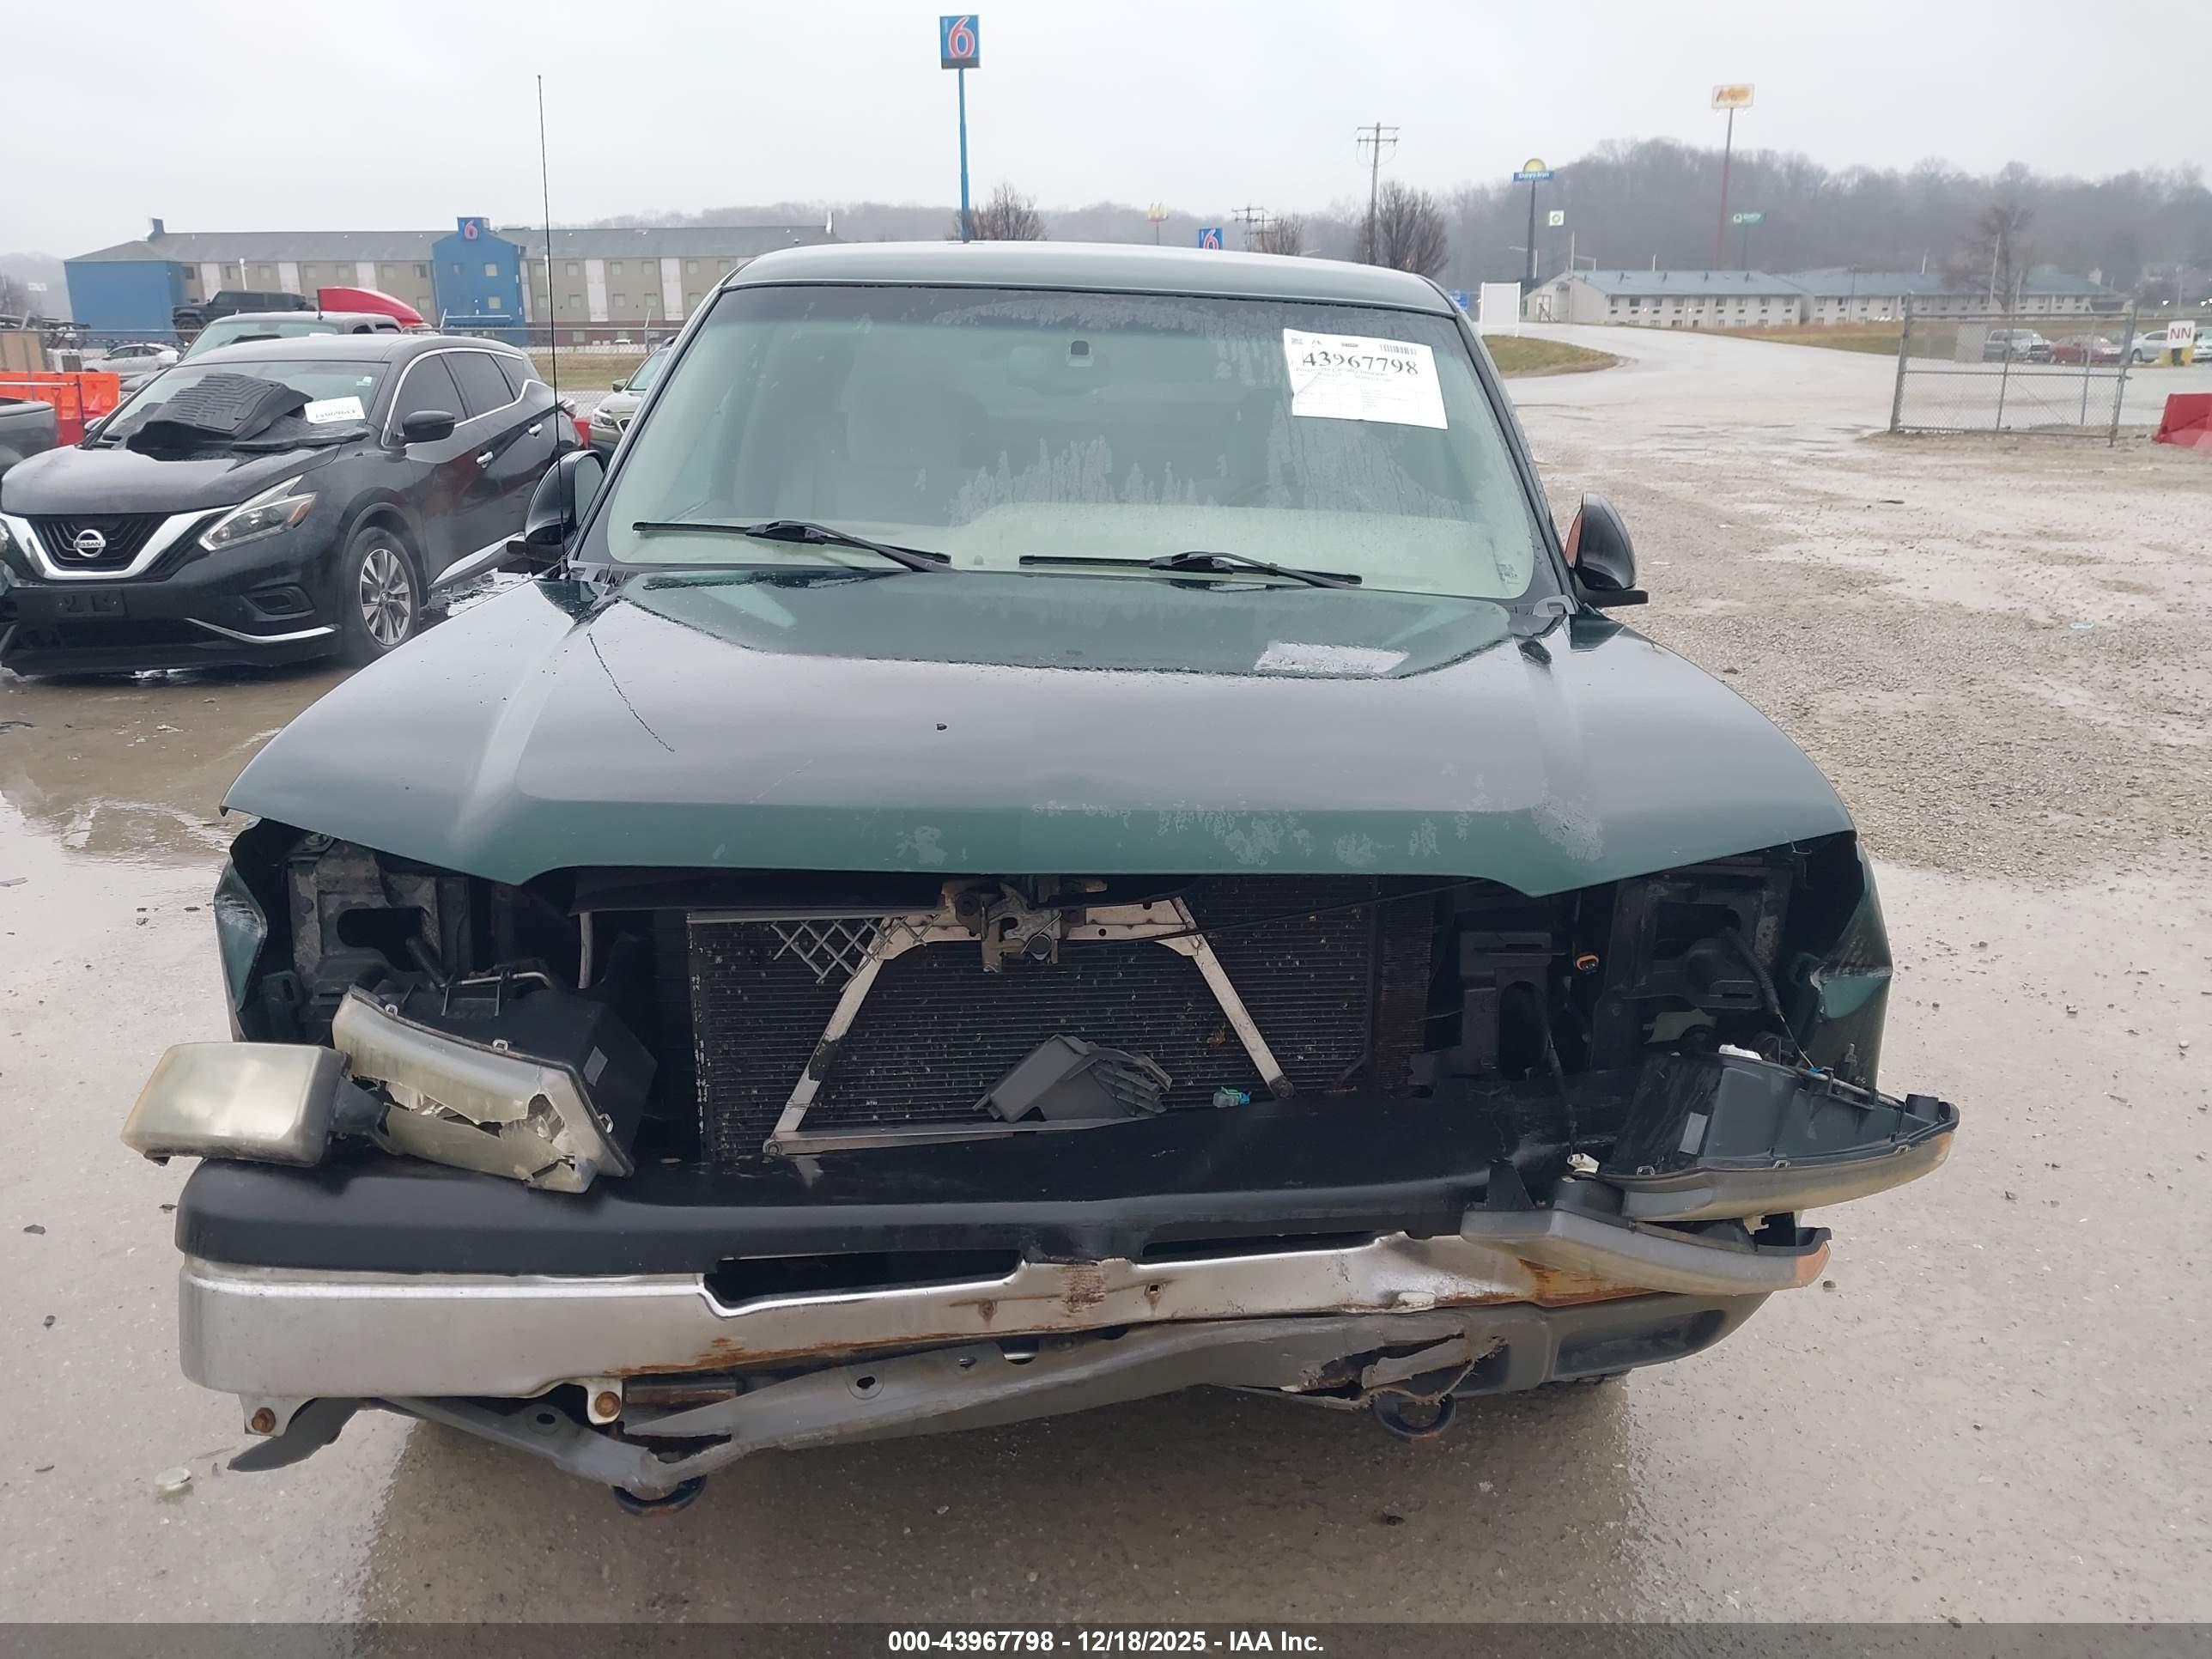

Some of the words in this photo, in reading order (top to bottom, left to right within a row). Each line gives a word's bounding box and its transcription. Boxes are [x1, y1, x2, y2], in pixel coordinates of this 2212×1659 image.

[949, 15, 975, 58] 6
[464, 219, 478, 240] 6
[1203, 228, 1219, 249] 6
[2170, 327, 2191, 339] NN
[1302, 349, 1419, 375] 43967798
